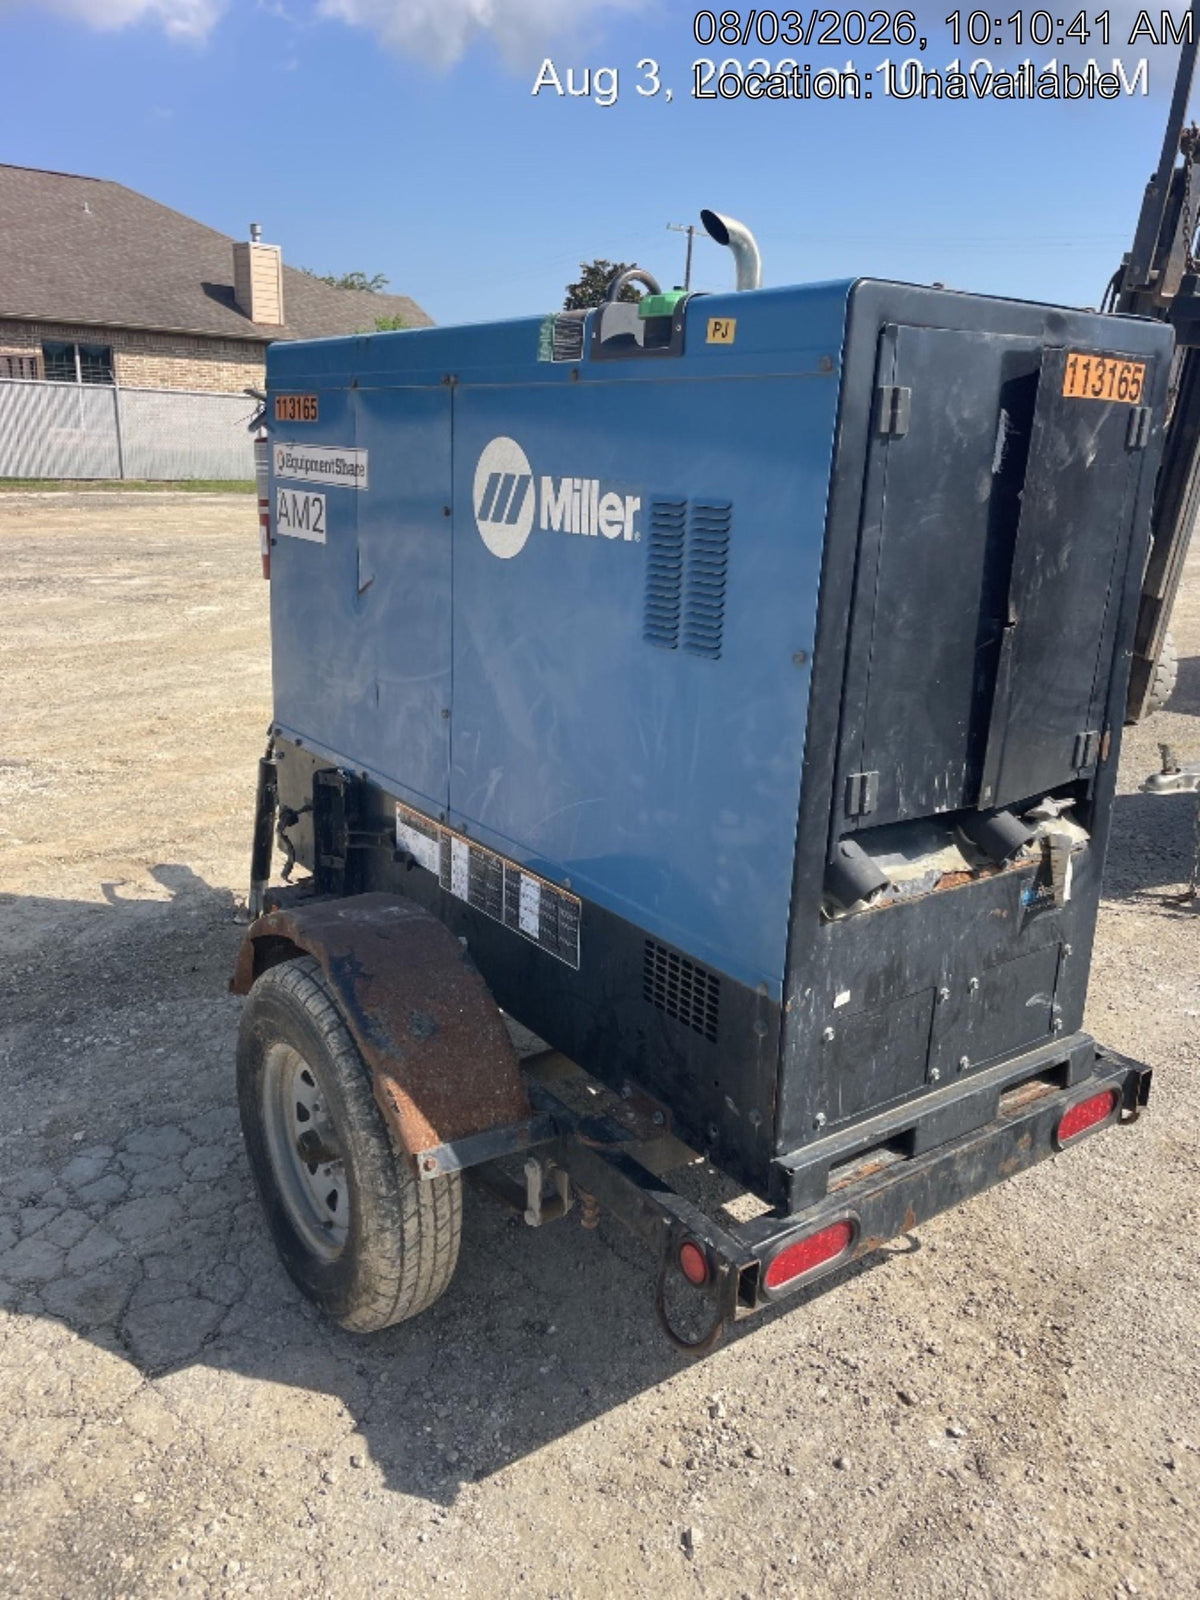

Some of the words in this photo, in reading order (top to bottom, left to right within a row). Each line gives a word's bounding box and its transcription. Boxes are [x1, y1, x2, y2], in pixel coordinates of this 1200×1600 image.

[712, 321, 730, 339] PJ
[1067, 356, 1142, 401] 113165
[276, 397, 318, 420] 113165
[286, 452, 365, 478] EquipmentShare
[277, 492, 325, 533] AM2
[540, 475, 641, 542] Miller
